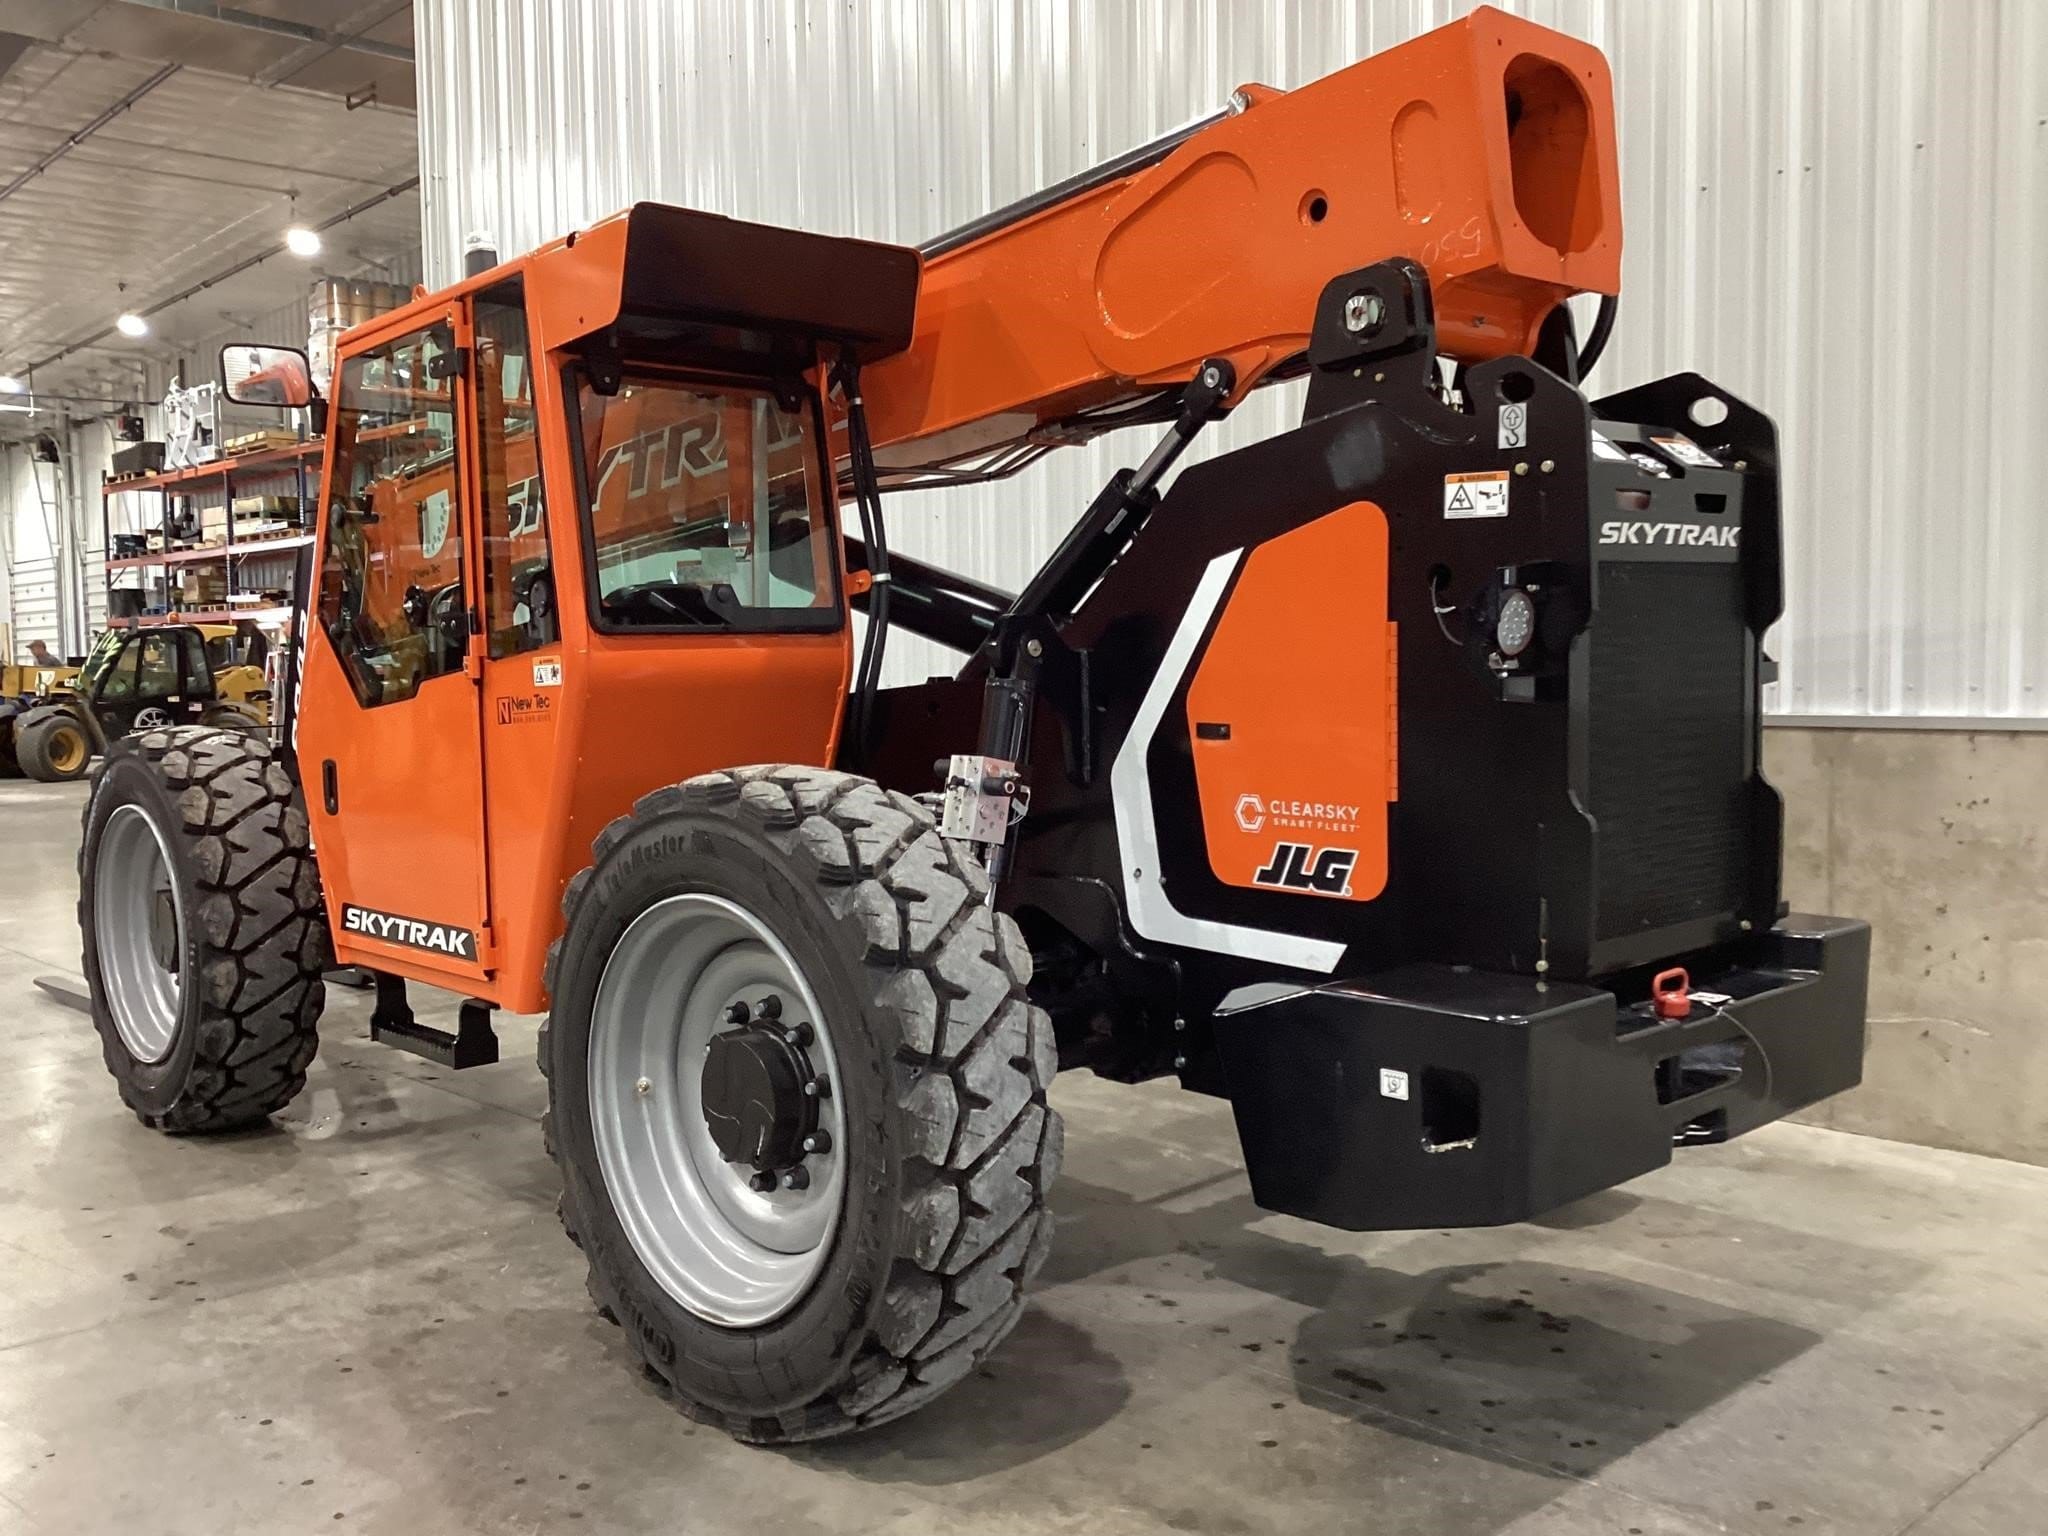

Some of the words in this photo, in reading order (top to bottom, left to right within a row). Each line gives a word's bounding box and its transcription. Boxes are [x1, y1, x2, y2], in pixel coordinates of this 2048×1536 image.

[1599, 521, 1741, 547] SKYTRAK
[511, 697, 533, 711] New
[533, 694, 550, 708] Tec
[1270, 800, 1360, 820] CLEARSKY
[1273, 817, 1312, 829] SMART
[1253, 841, 1359, 896] JLG
[345, 907, 469, 956] SKYTRAK
